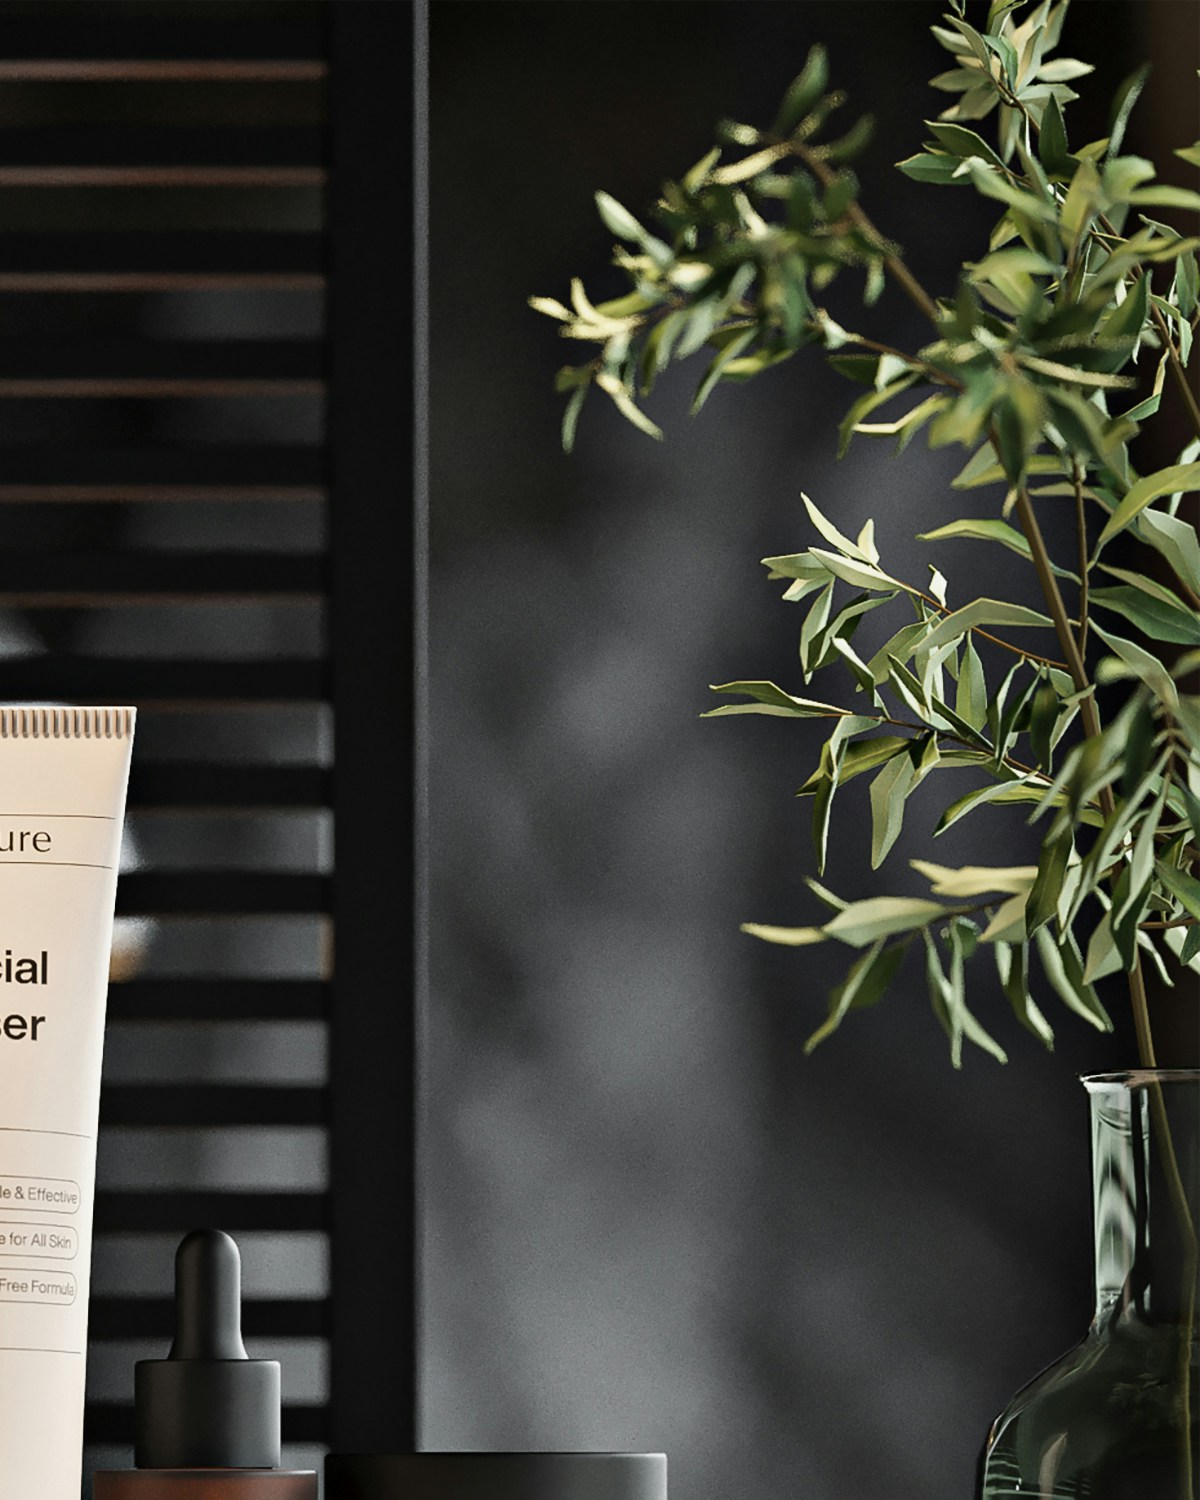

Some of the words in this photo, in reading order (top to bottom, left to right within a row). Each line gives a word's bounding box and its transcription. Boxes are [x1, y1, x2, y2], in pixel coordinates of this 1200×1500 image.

[14, 1185, 25, 1200] &
[28, 1186, 78, 1205] Effective
[9, 1232, 28, 1246] for
[30, 1233, 47, 1247] All
[49, 1234, 72, 1249] Skin
[31, 1280, 75, 1297] Formula
